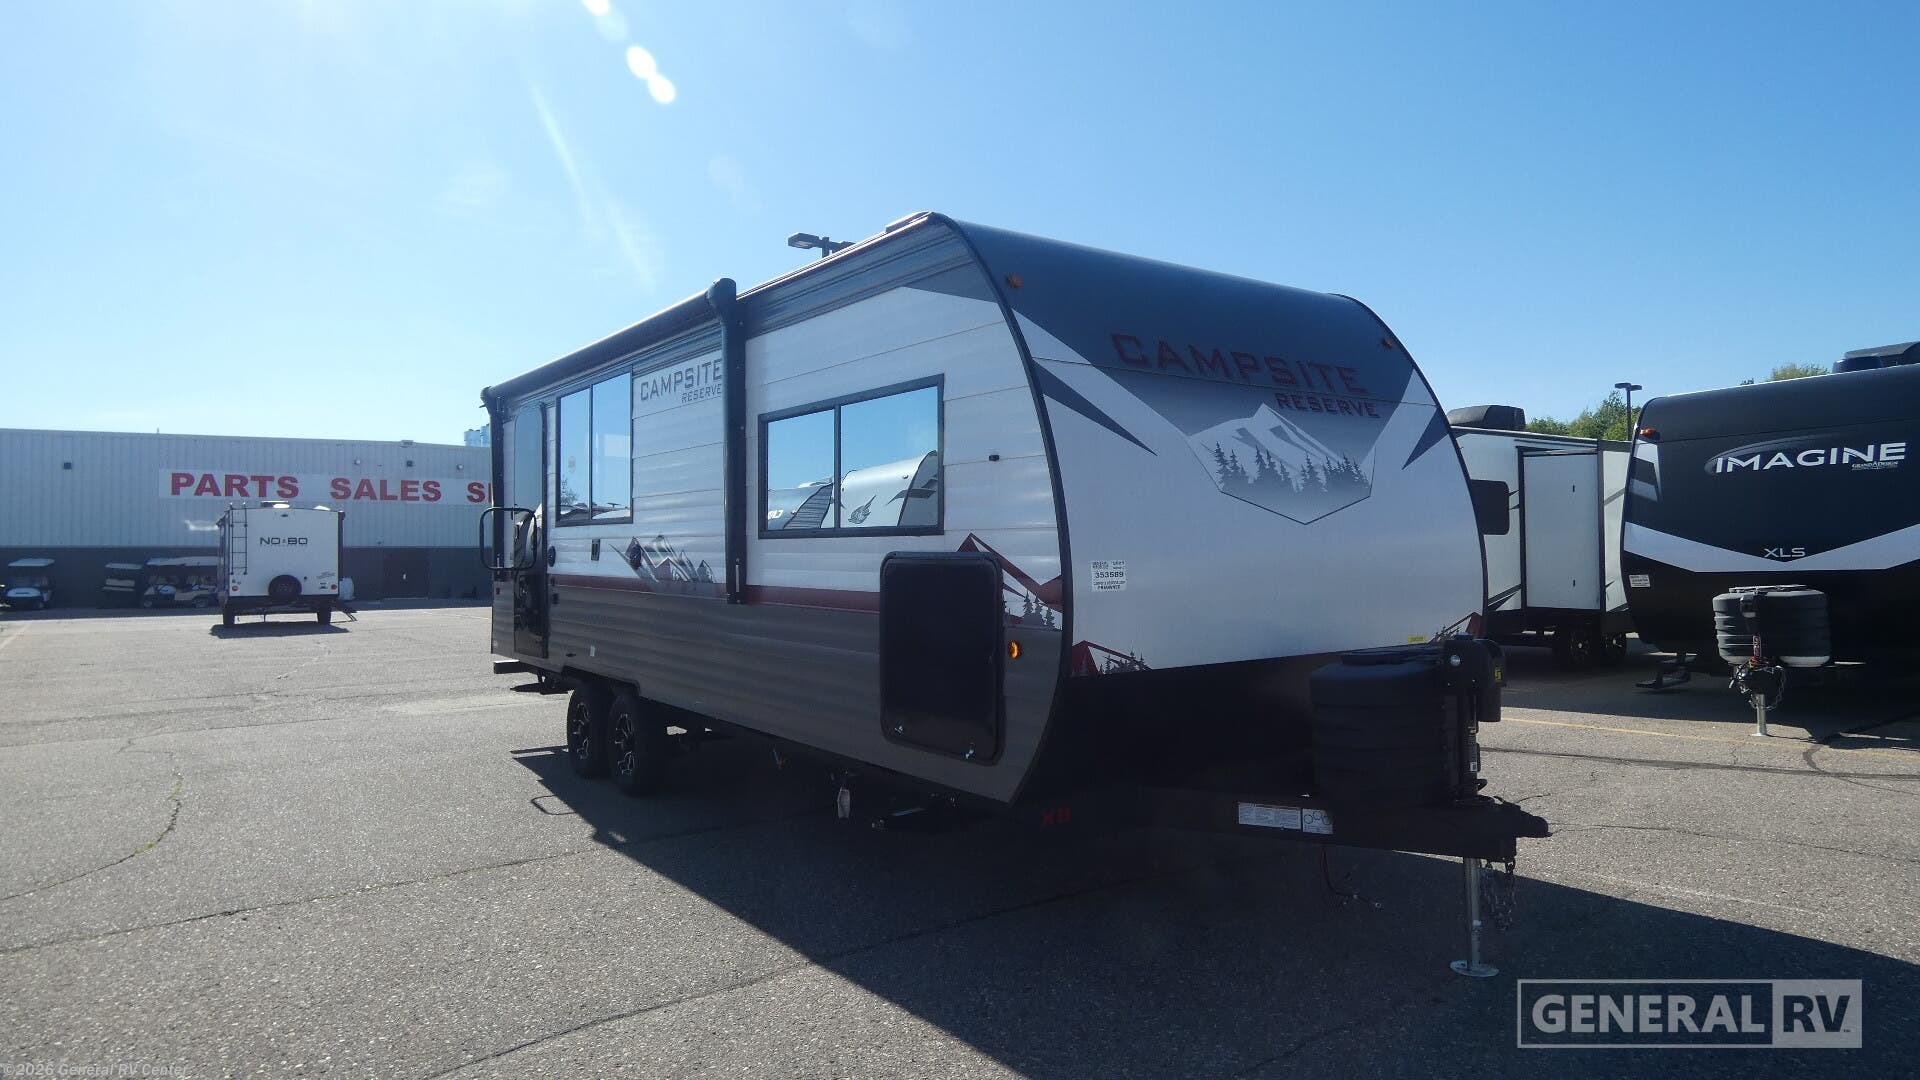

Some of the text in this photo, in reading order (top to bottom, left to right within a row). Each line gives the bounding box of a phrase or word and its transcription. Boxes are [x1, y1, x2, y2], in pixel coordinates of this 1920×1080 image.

[640, 358, 722, 401] CAMPSITE
[1111, 333, 1368, 396] CAMPSITE
[681, 384, 722, 403] RESERVE
[1275, 392, 1380, 418] RESERVE
[1716, 442, 1906, 473] IMAGINE
[171, 472, 299, 498] PARTS
[330, 478, 441, 502] SALES
[1764, 547, 1806, 558] XLS
